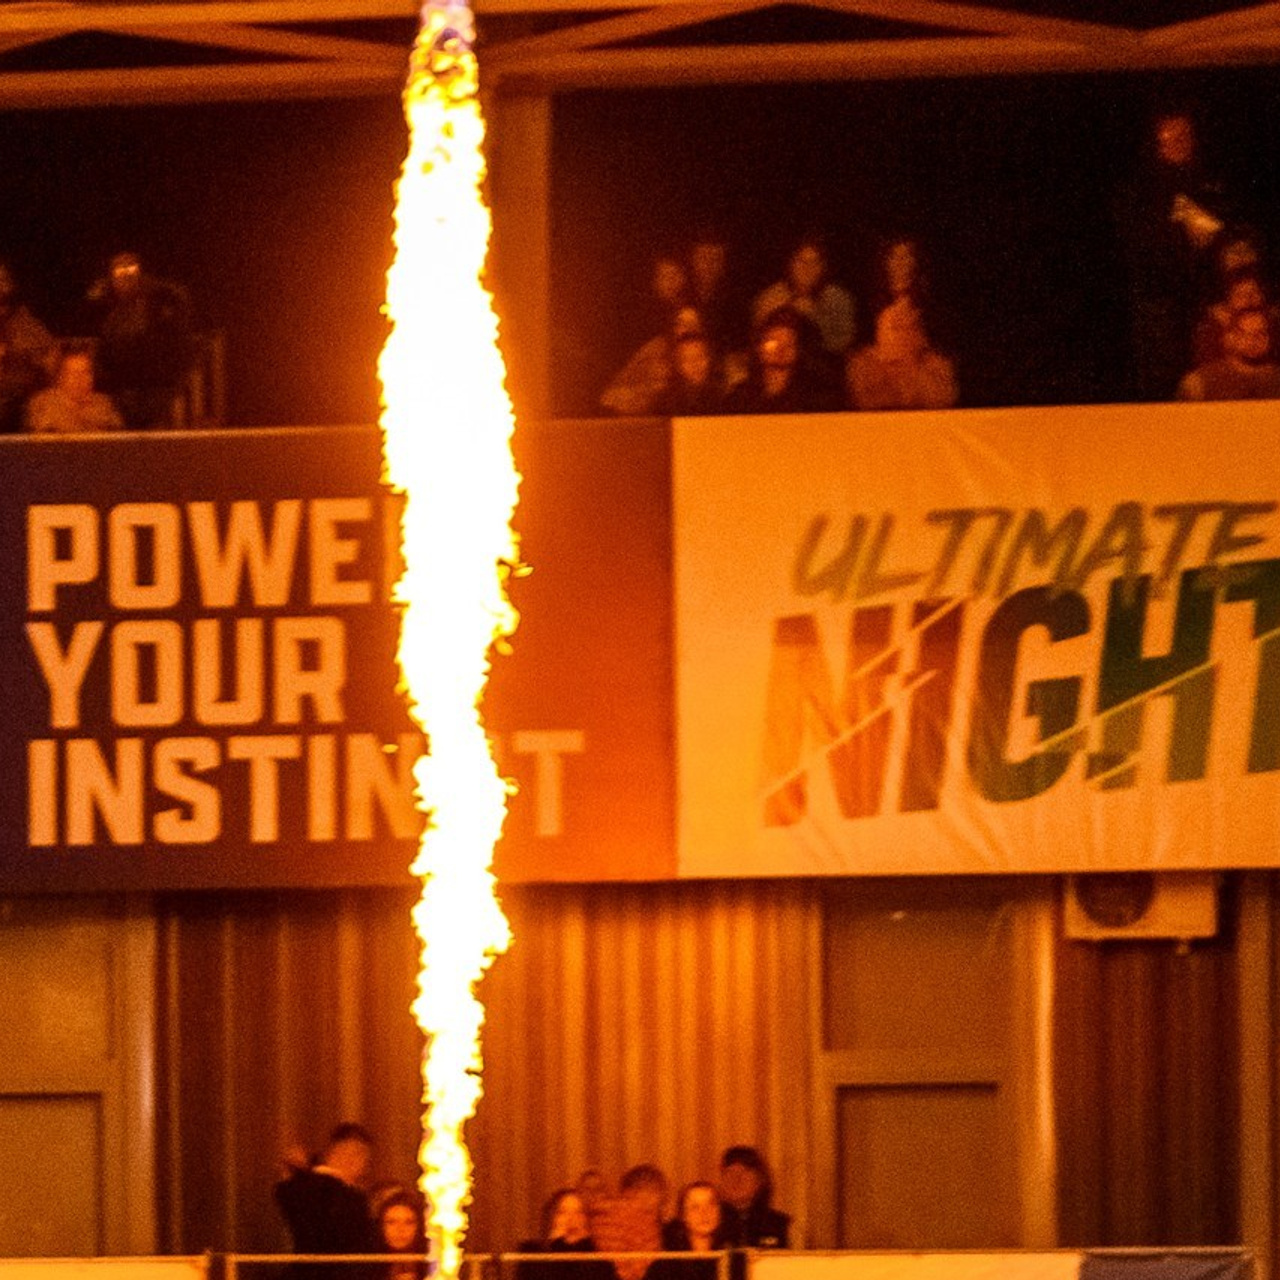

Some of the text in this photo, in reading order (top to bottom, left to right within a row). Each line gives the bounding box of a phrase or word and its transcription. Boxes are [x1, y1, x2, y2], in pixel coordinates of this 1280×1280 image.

[27, 498, 408, 612] POWE
[795, 502, 1277, 602] ULTIMATE
[26, 617, 347, 728] YOUR
[764, 560, 1280, 828] NIGHT
[27, 731, 585, 846] INSTINT
